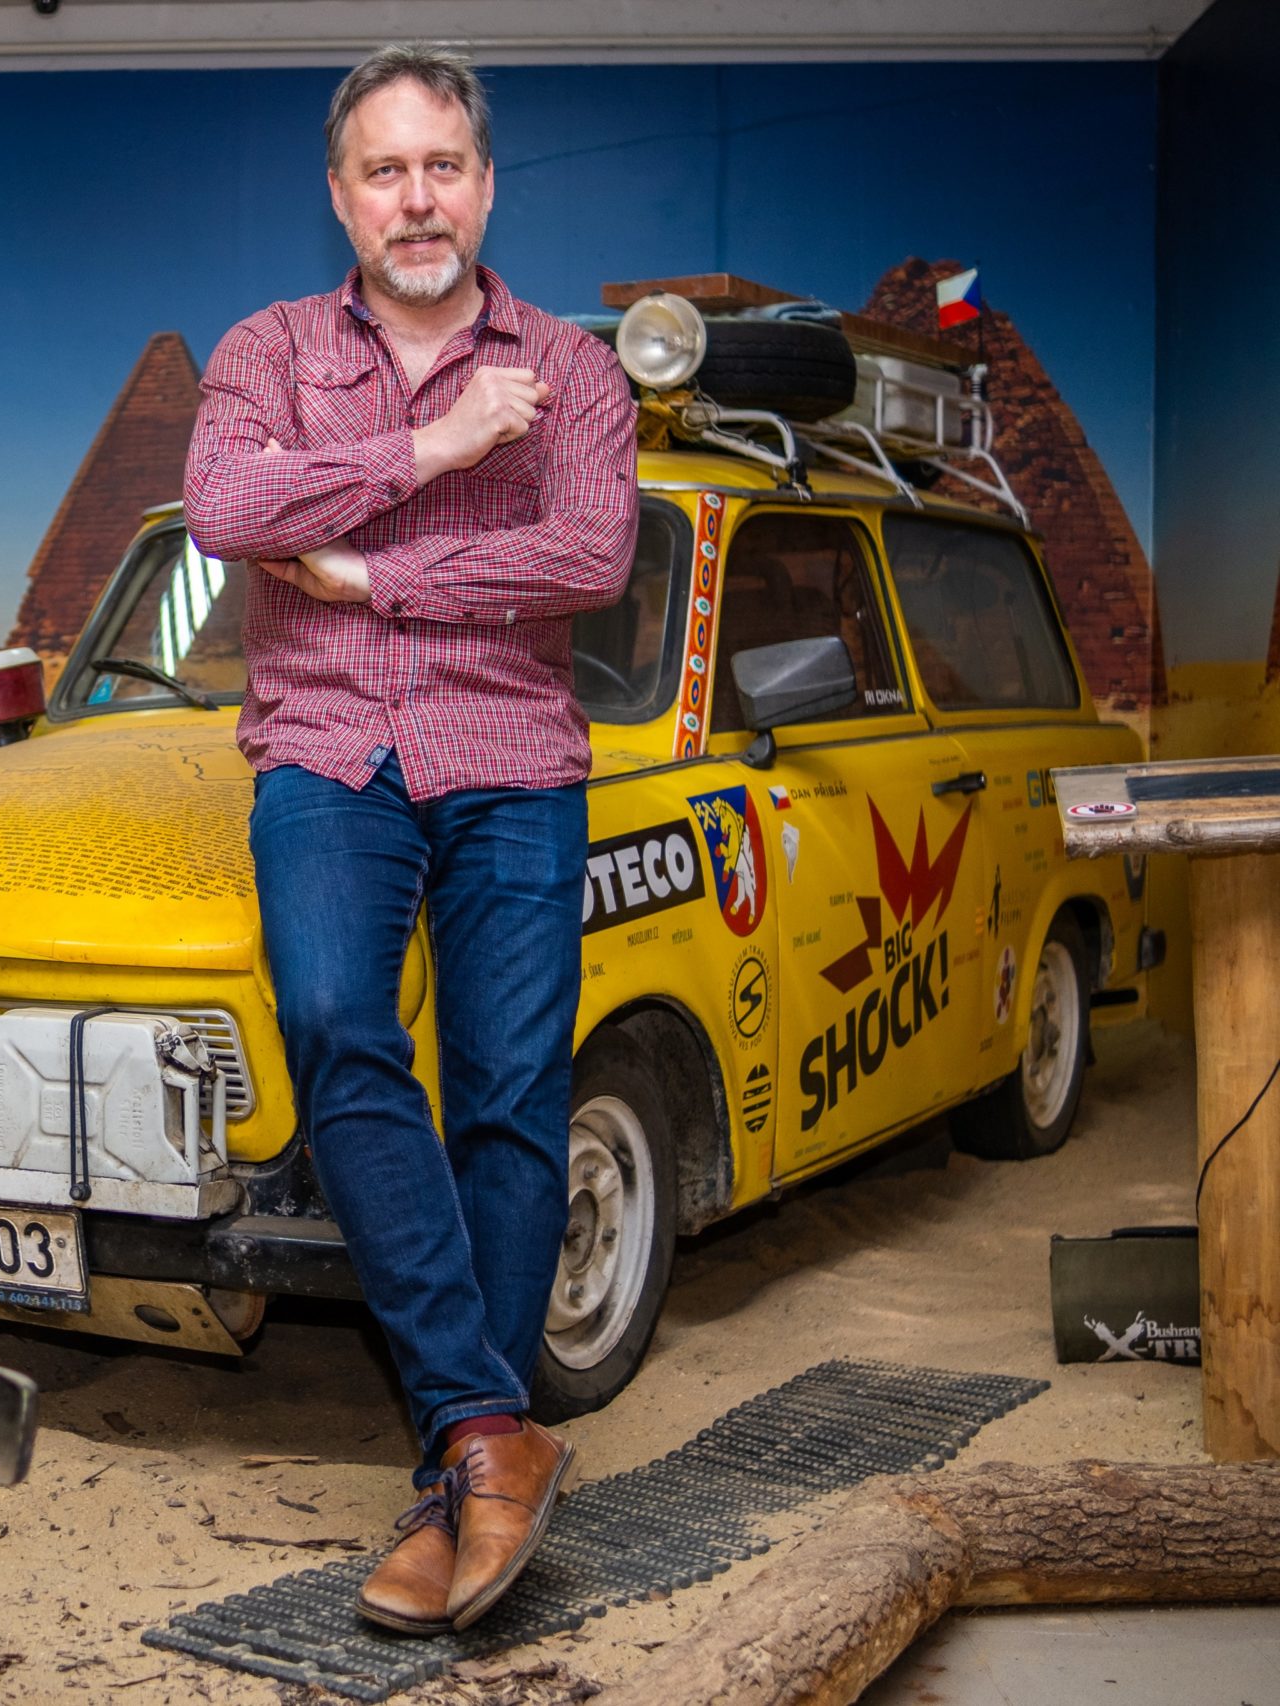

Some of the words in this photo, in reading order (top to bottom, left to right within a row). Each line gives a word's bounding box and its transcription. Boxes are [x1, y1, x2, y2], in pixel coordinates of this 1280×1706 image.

[791, 788, 811, 800] DAN
[884, 920, 912, 975] BIG
[799, 929, 949, 1132] SHOCK!
